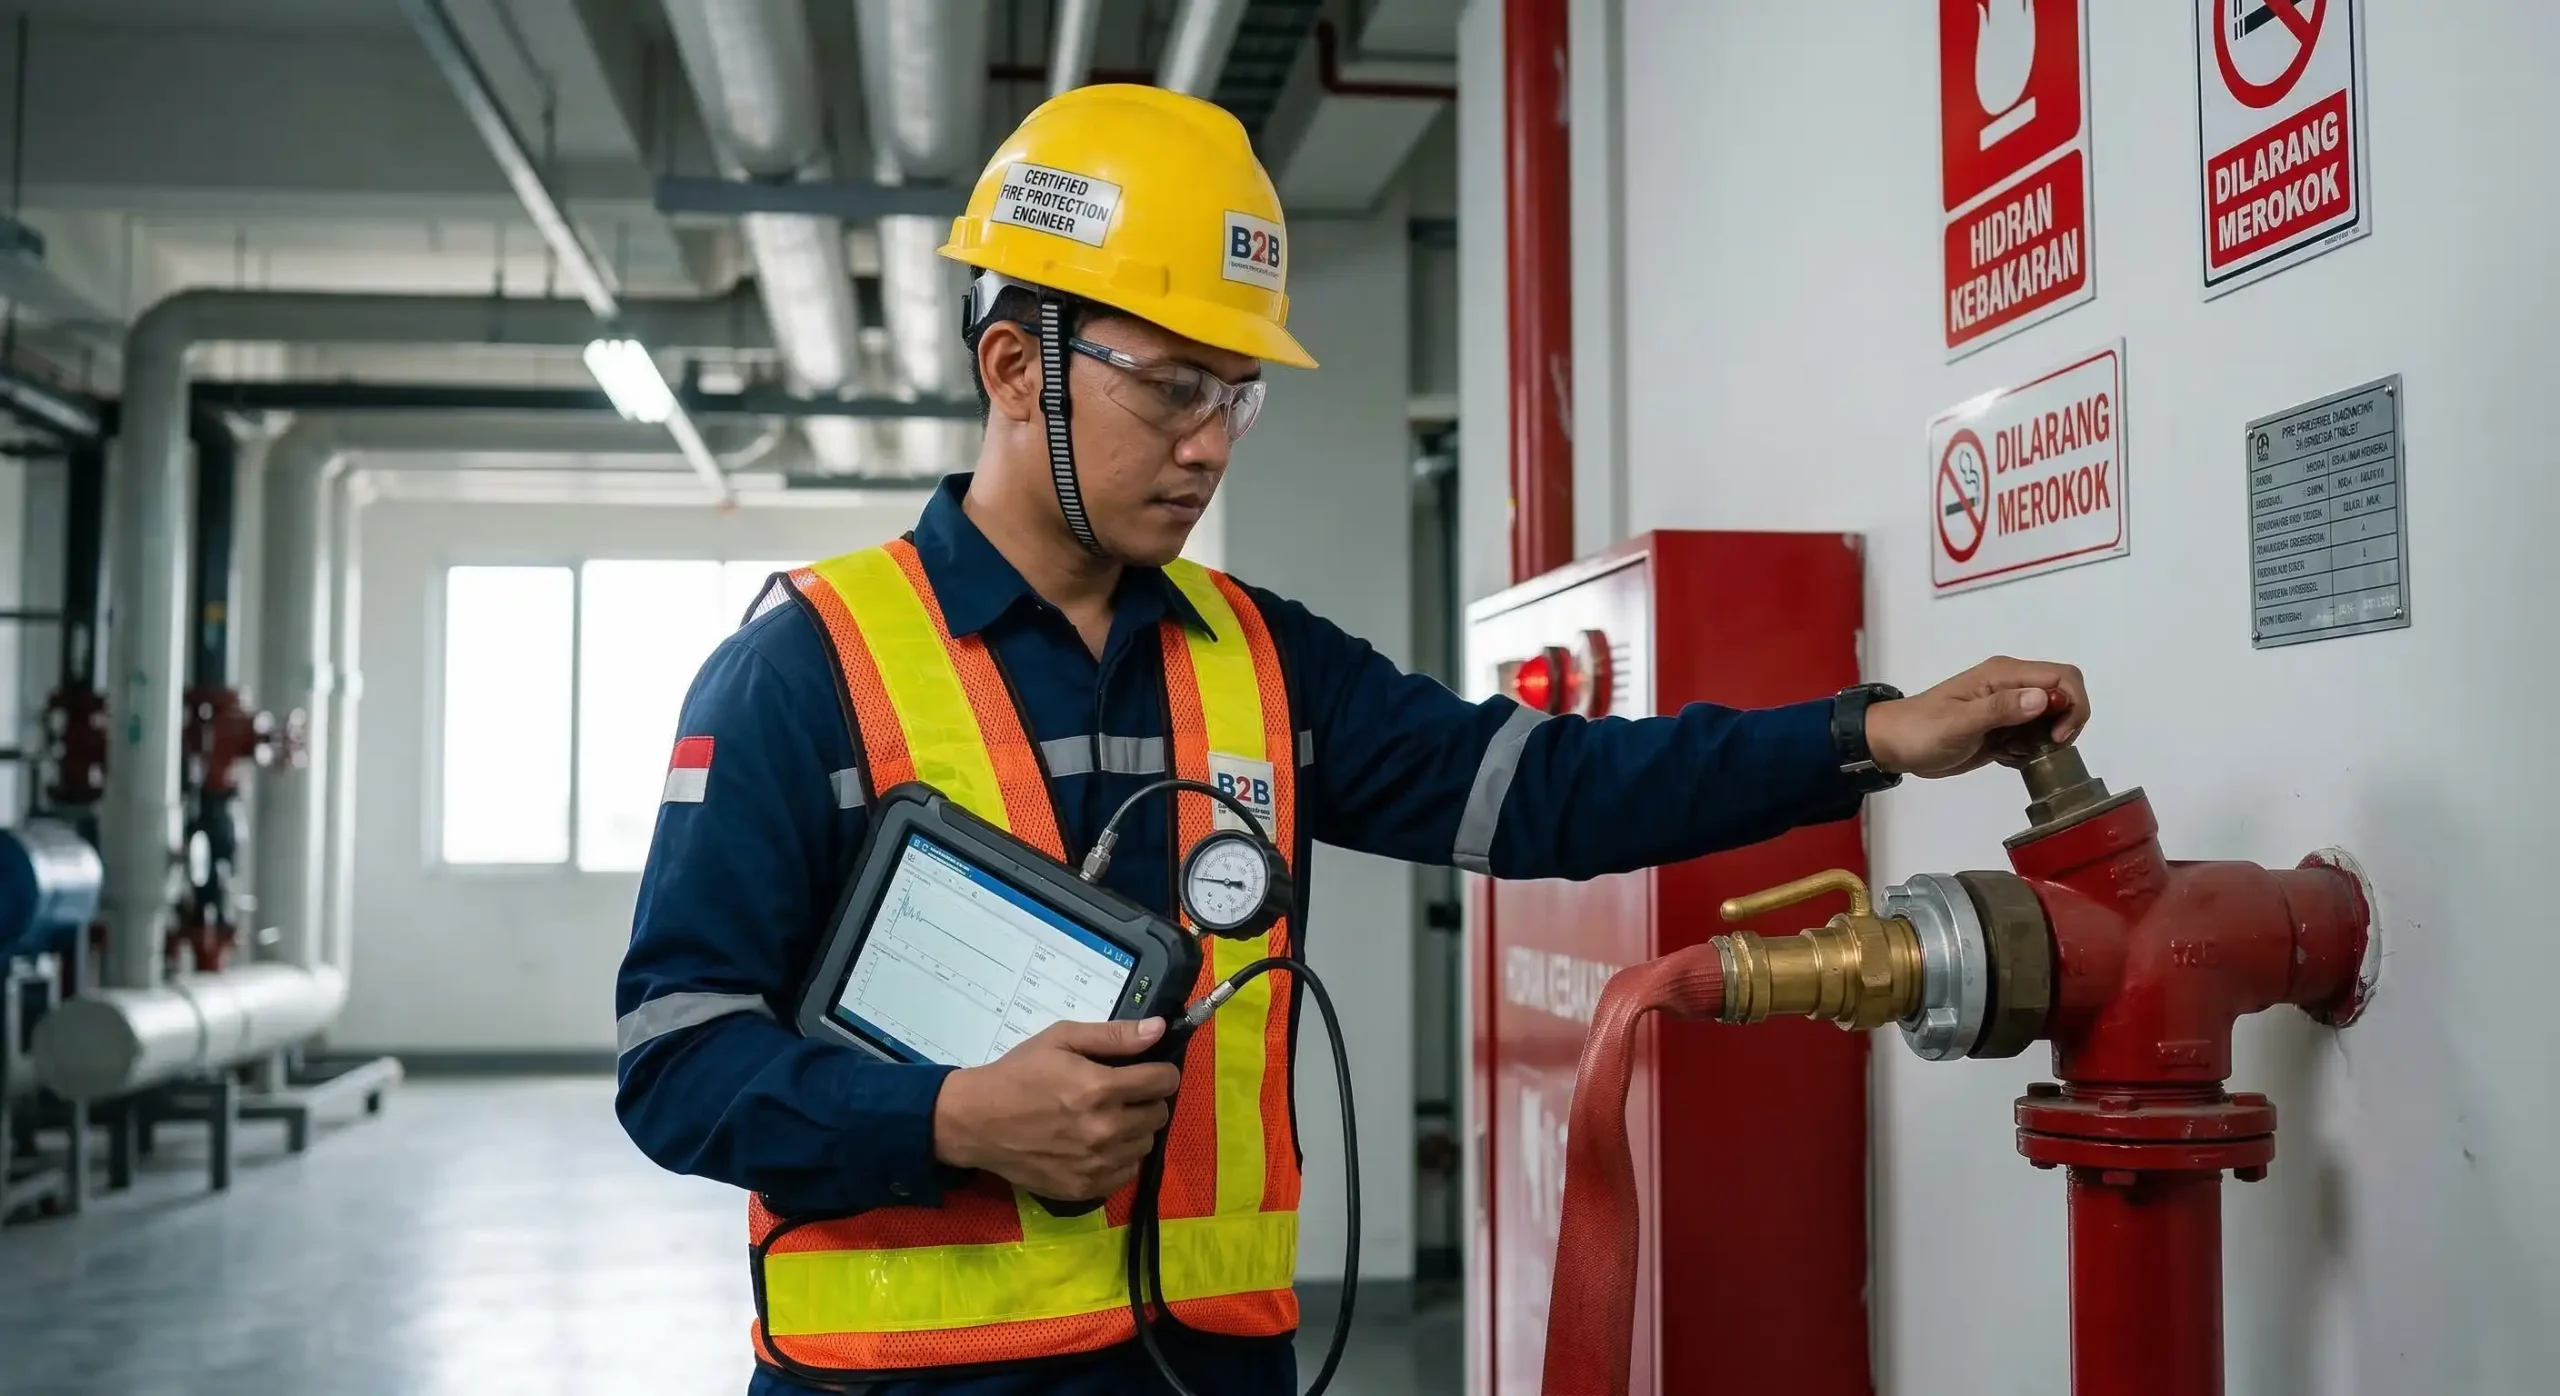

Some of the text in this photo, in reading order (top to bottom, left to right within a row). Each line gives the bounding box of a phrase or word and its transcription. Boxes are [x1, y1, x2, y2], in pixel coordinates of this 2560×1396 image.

[1025, 169, 1089, 196] CERTIFIED
[2215, 111, 2339, 205] DILARANG
[1000, 184, 1109, 222] FIRE PROTECTION
[1012, 205, 1076, 233] ENGINEER
[1970, 182, 2053, 269] HIDRAN
[2218, 161, 2341, 252] MEROKOK
[1231, 225, 1280, 268] B2B
[1951, 228, 2079, 333] KEBAKARAN
[1996, 392, 2110, 475] DILARANG
[1998, 460, 2111, 537] MEROKOK
[1217, 772, 1271, 806] B2B
